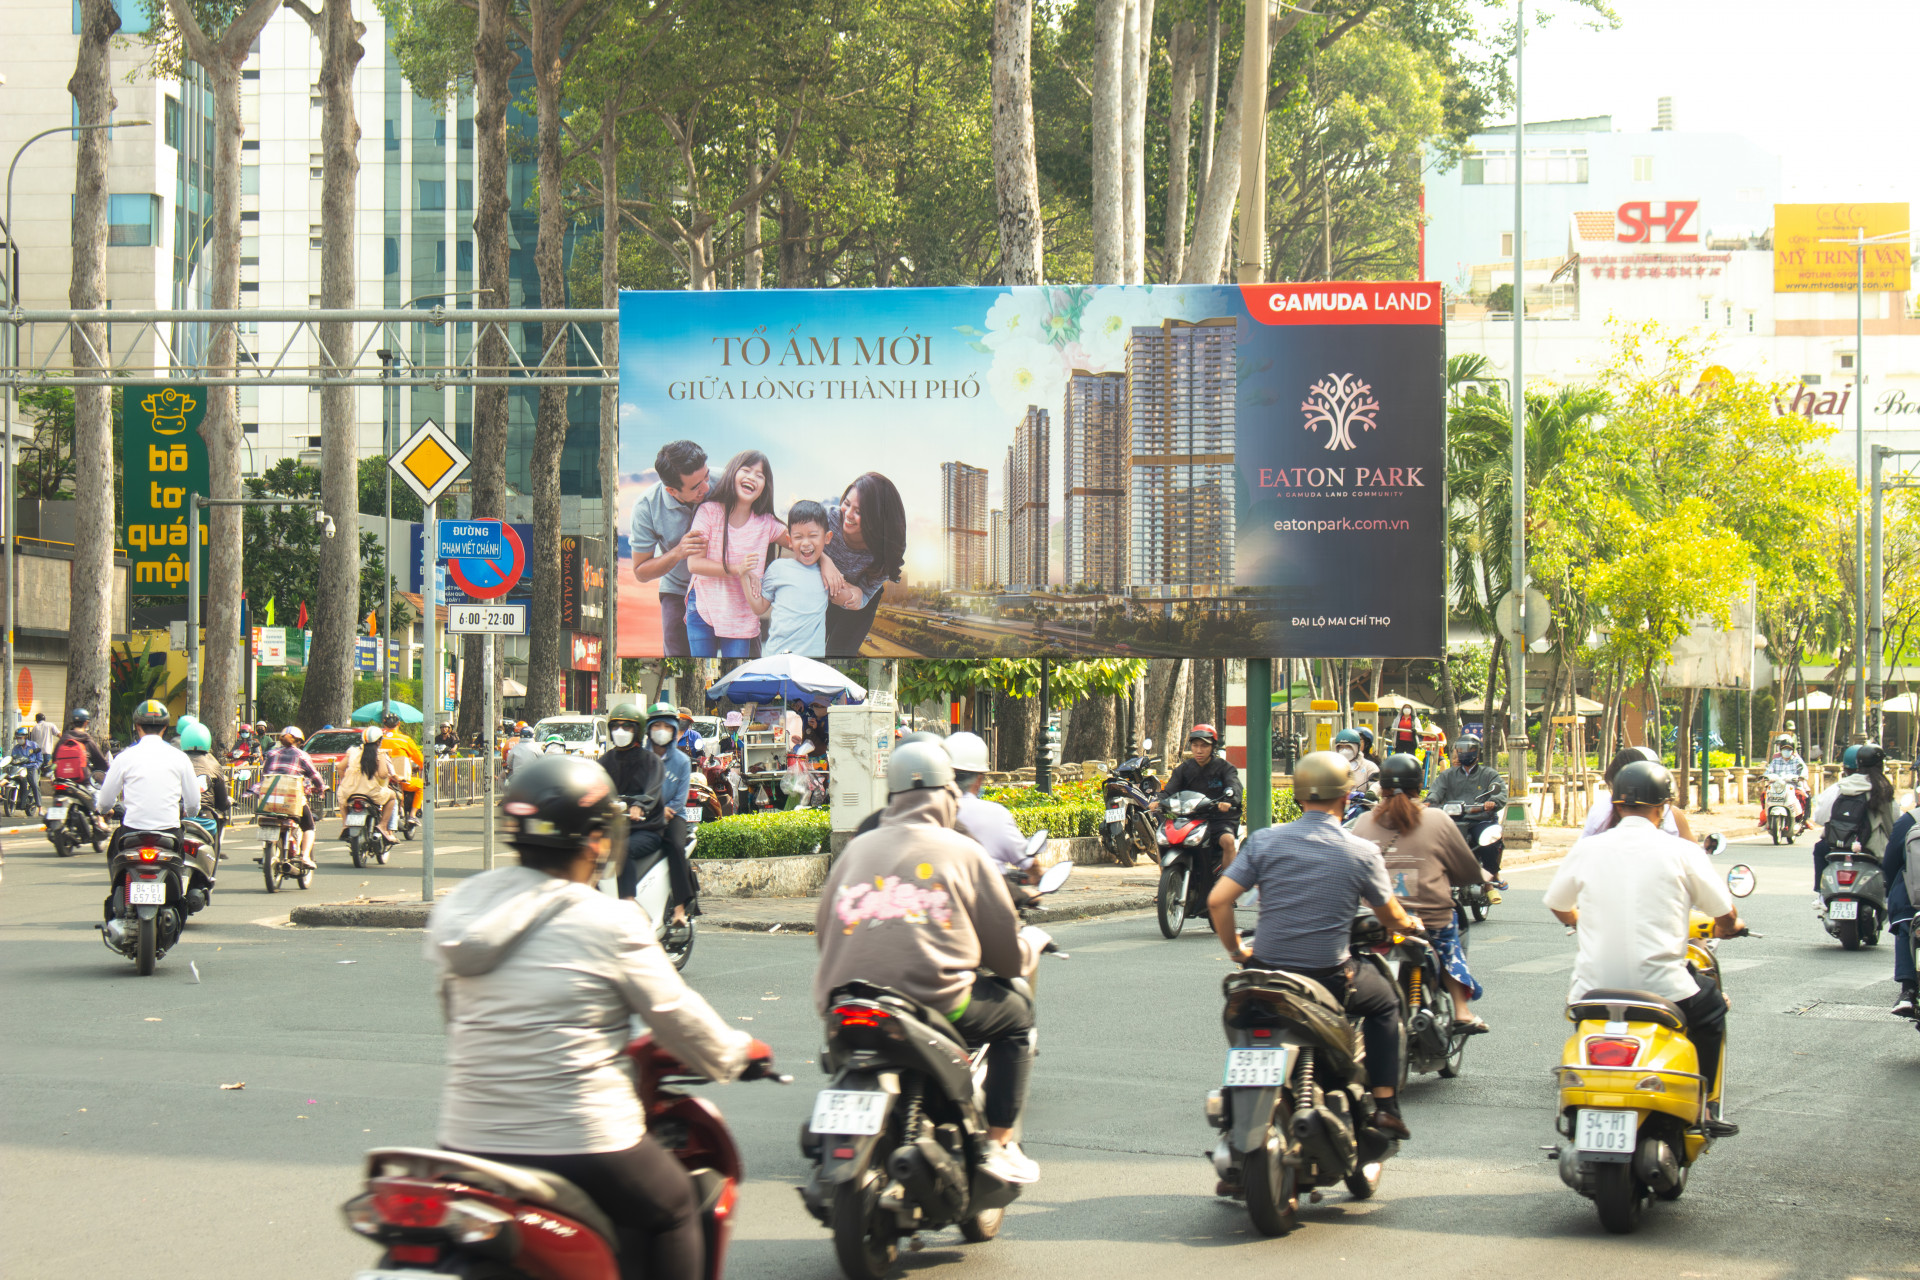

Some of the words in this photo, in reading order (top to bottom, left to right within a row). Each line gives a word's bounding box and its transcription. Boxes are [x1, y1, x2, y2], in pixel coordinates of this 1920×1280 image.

[1617, 200, 1698, 243] SHZ
[1779, 247, 1806, 265] MỸ
[1812, 249, 1868, 265] TRINH
[1874, 246, 1906, 265] VÂN
[1268, 293, 1368, 312] GAMUDA
[1375, 292, 1432, 311] LAND
[712, 325, 771, 367] TỔ
[778, 324, 841, 367] ẤM
[853, 325, 933, 367] MỚI
[668, 376, 735, 400] GIỮA
[741, 375, 814, 400] LÒNG
[821, 375, 917, 400] THÀNH
[925, 372, 981, 399] PHỐ
[1873, 389, 1920, 416] Bo
[1258, 467, 1345, 488] EATON
[1355, 467, 1425, 488] PARK
[150, 481, 186, 509] tơ
[128, 516, 208, 552] quán
[453, 525, 489, 536] ĐƯỜNG
[1273, 517, 1410, 533] eatonpark.com.vn
[442, 542, 461, 556] PHẠM
[462, 539, 476, 555] VIẾT
[476, 541, 500, 555] CHÁNH
[563, 553, 574, 575] SOFA
[563, 576, 574, 625] GALAXY
[1291, 617, 1310, 628] ĐẠI
[1312, 616, 1326, 628] LỘ
[1328, 617, 1347, 626] MAI
[1349, 615, 1367, 626] CHÍ
[1369, 616, 1391, 627] THỌ
[1586, 1112, 1627, 1131] 54-H1
[1585, 1131, 1627, 1149] 1003
